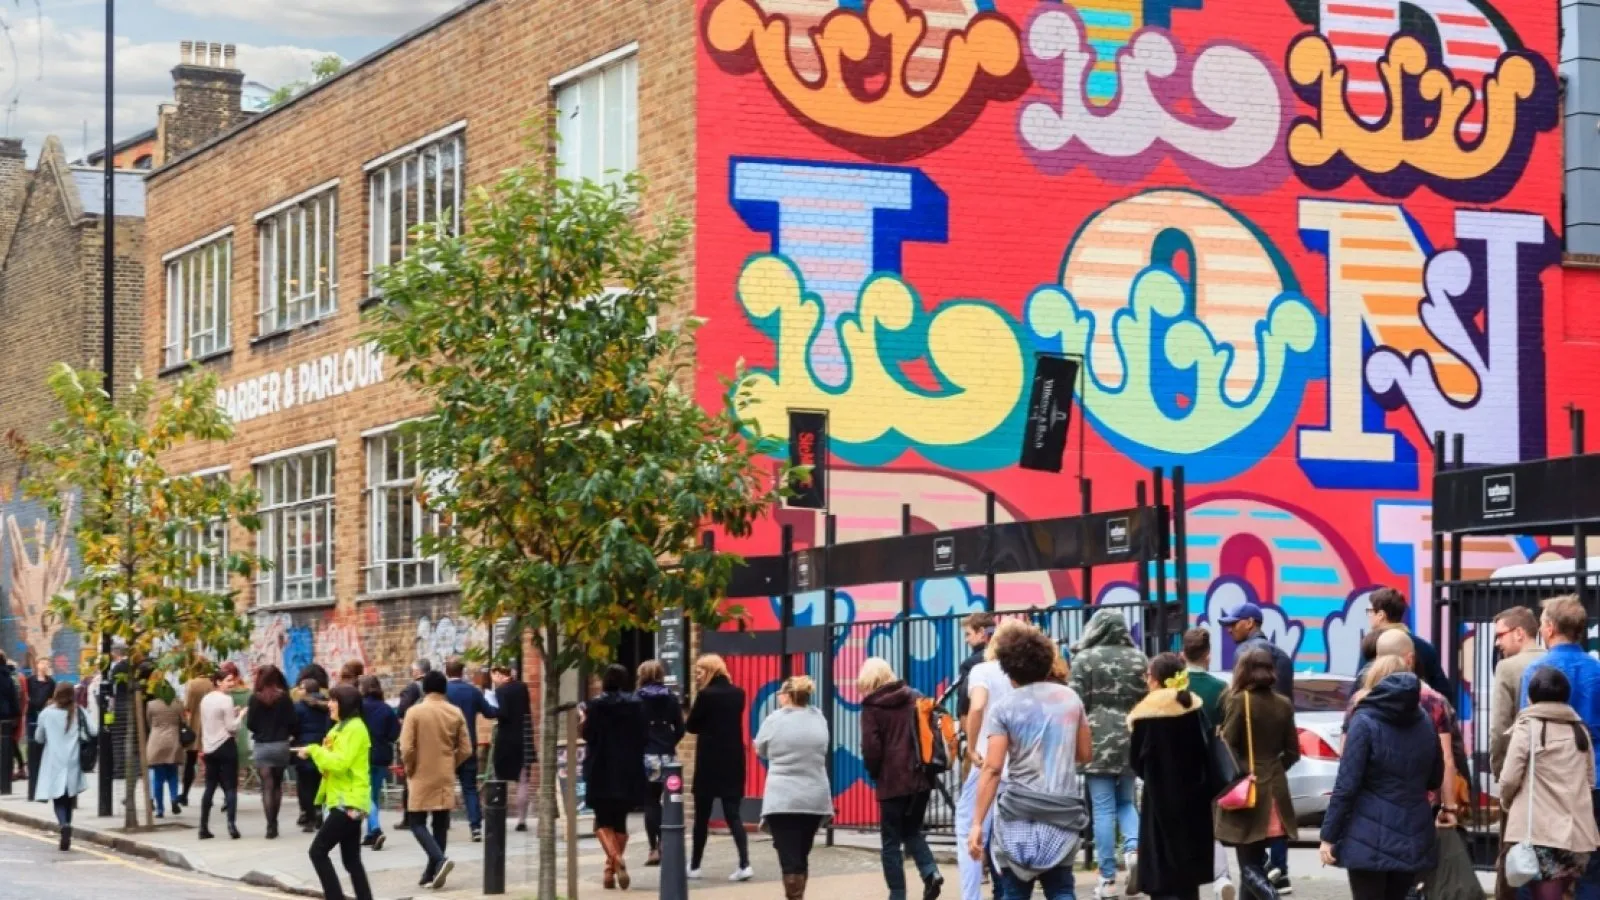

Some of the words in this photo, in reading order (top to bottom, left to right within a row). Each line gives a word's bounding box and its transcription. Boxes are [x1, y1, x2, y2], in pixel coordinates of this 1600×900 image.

[216, 371, 280, 423] BARBER
[283, 367, 296, 409] &
[299, 341, 385, 405] PARLOUR
